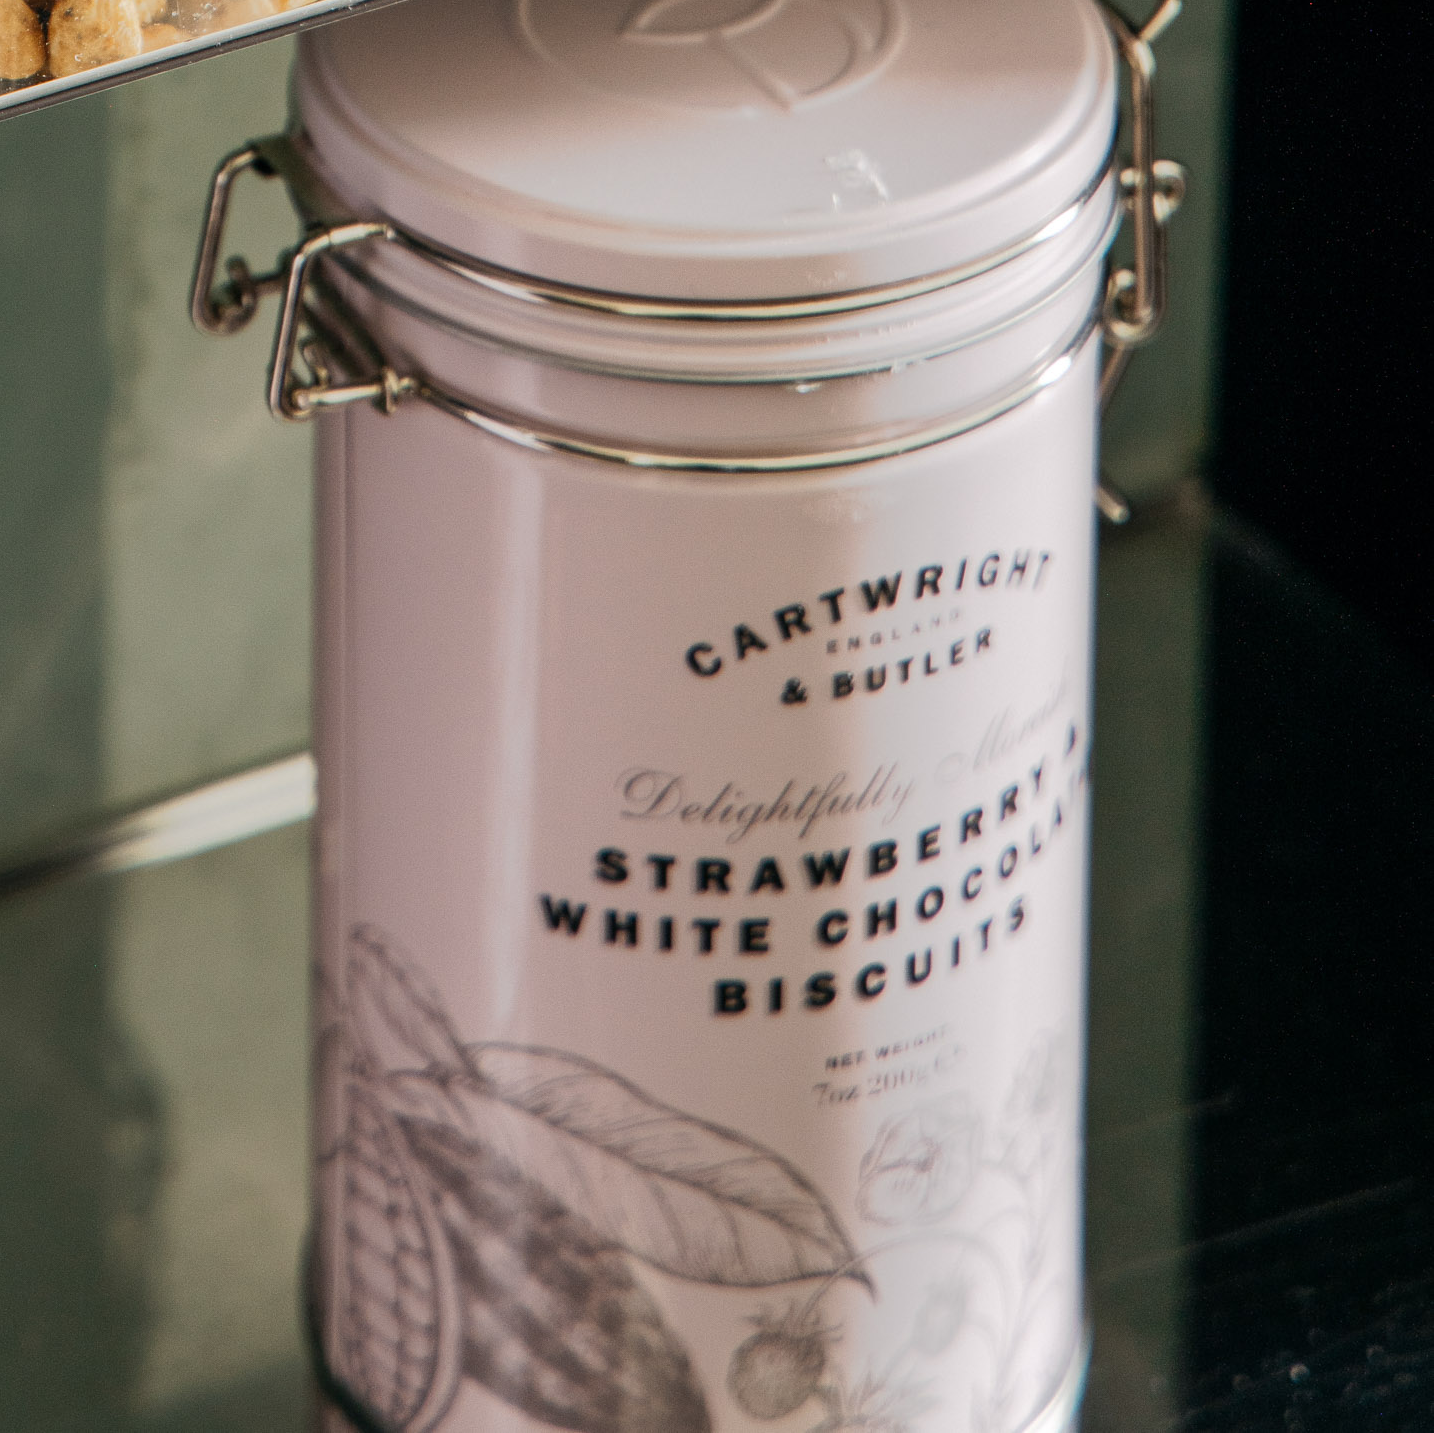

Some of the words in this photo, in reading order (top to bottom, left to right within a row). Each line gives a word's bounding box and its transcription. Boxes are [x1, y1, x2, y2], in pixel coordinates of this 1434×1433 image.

[684, 547, 1052, 679] CARTWRIGHT
[825, 608, 962, 656] ENGLAND
[779, 678, 808, 706] &
[831, 626, 995, 701] BUTLER
[594, 763, 1047, 895] STRAWBERRY
[615, 763, 916, 845] Delightfully
[539, 893, 770, 954] WHITE
[713, 894, 1030, 1017] BISCUITS
